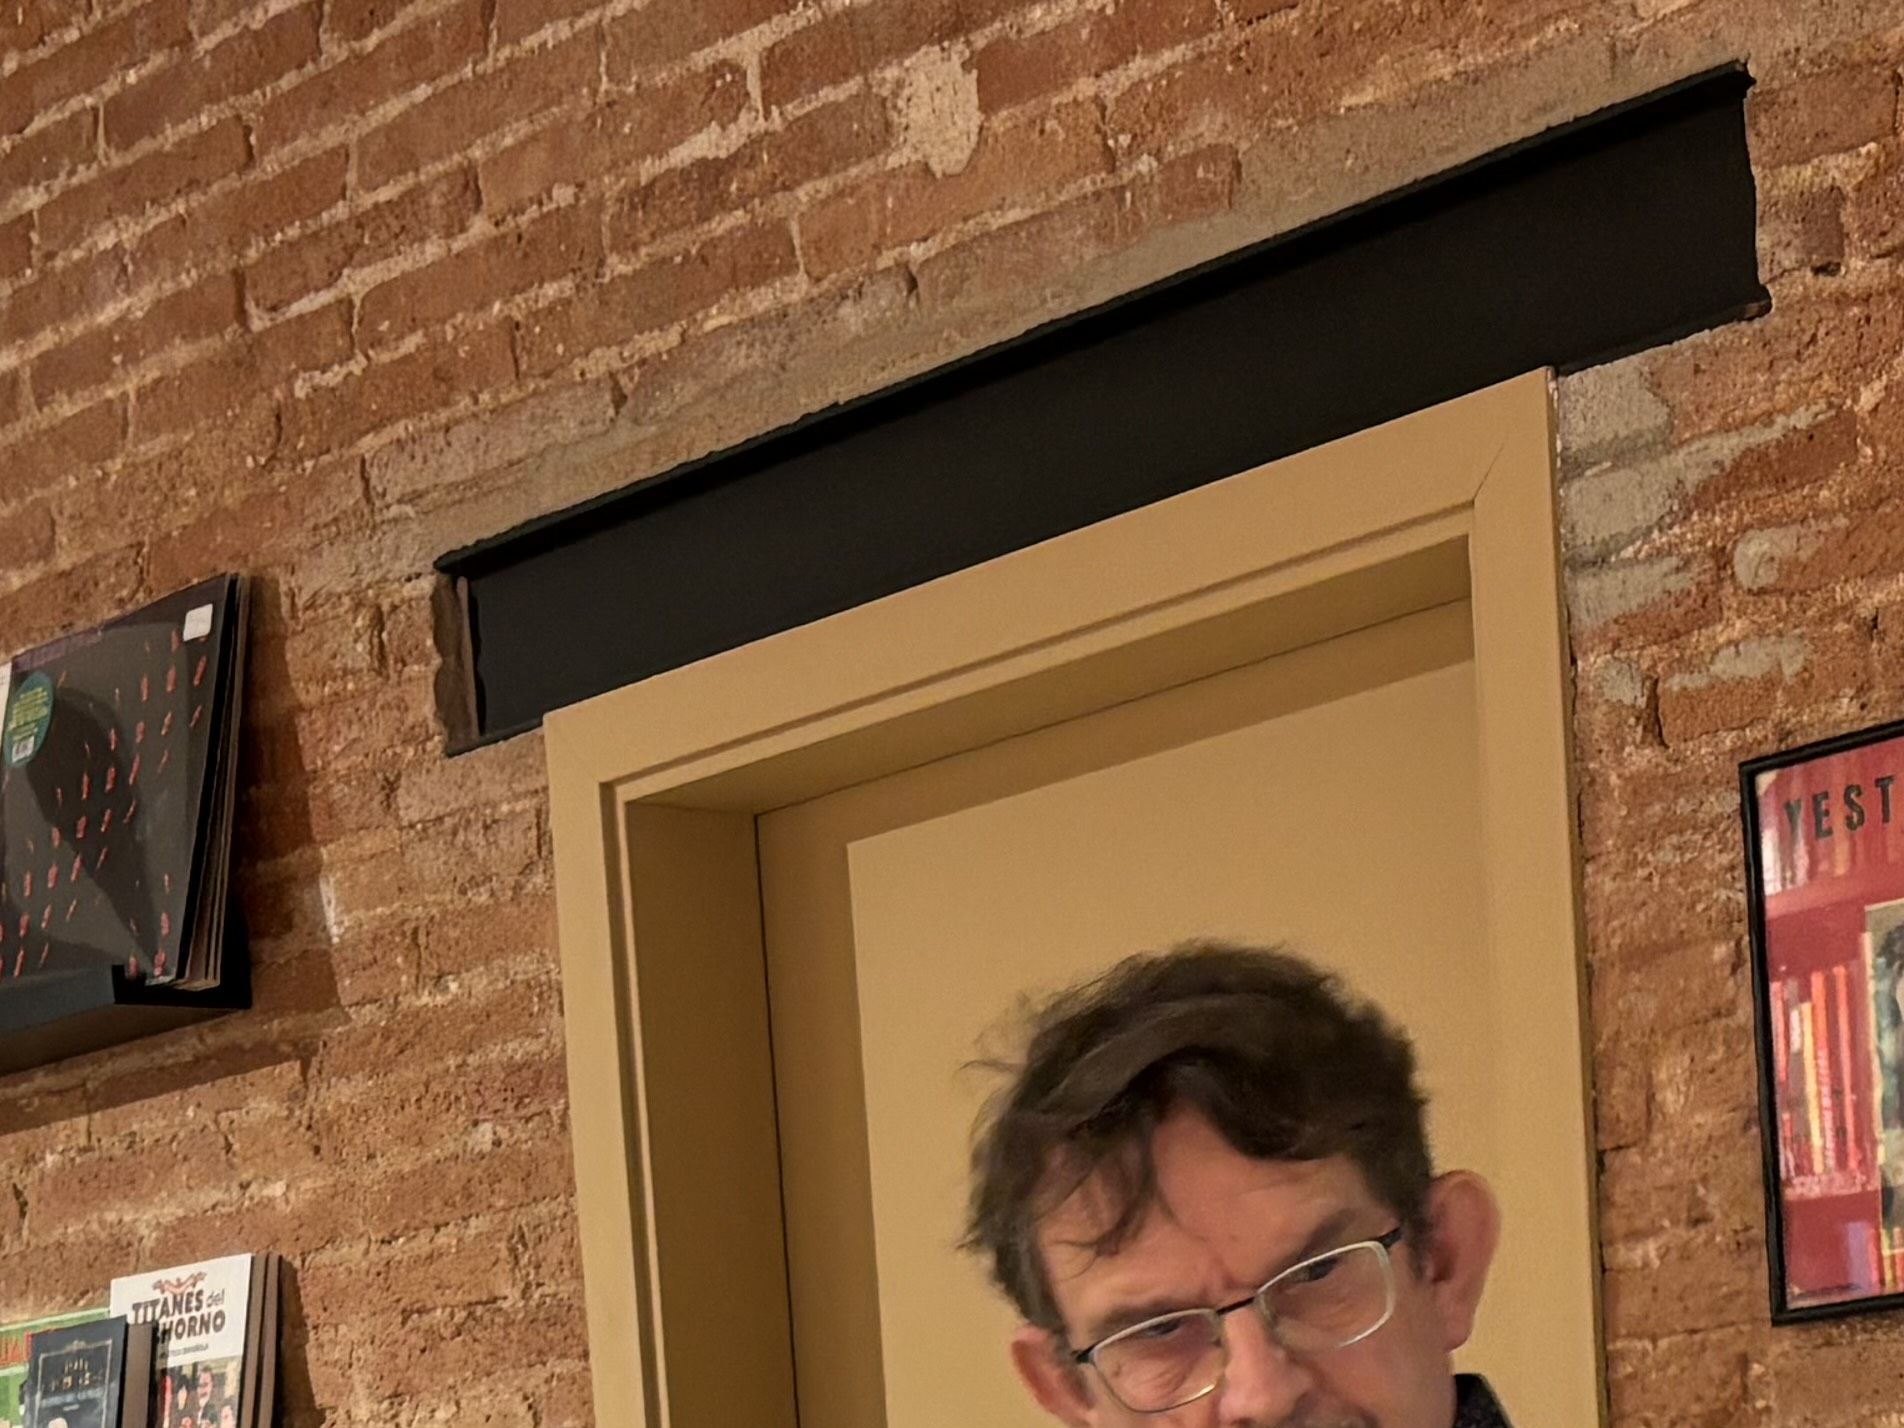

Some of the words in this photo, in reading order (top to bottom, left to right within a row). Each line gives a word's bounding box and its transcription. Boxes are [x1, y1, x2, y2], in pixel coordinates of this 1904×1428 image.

[132, 1289, 204, 1324] TITANES
[206, 1288, 226, 1307] del
[162, 1310, 226, 1344] HORNO
